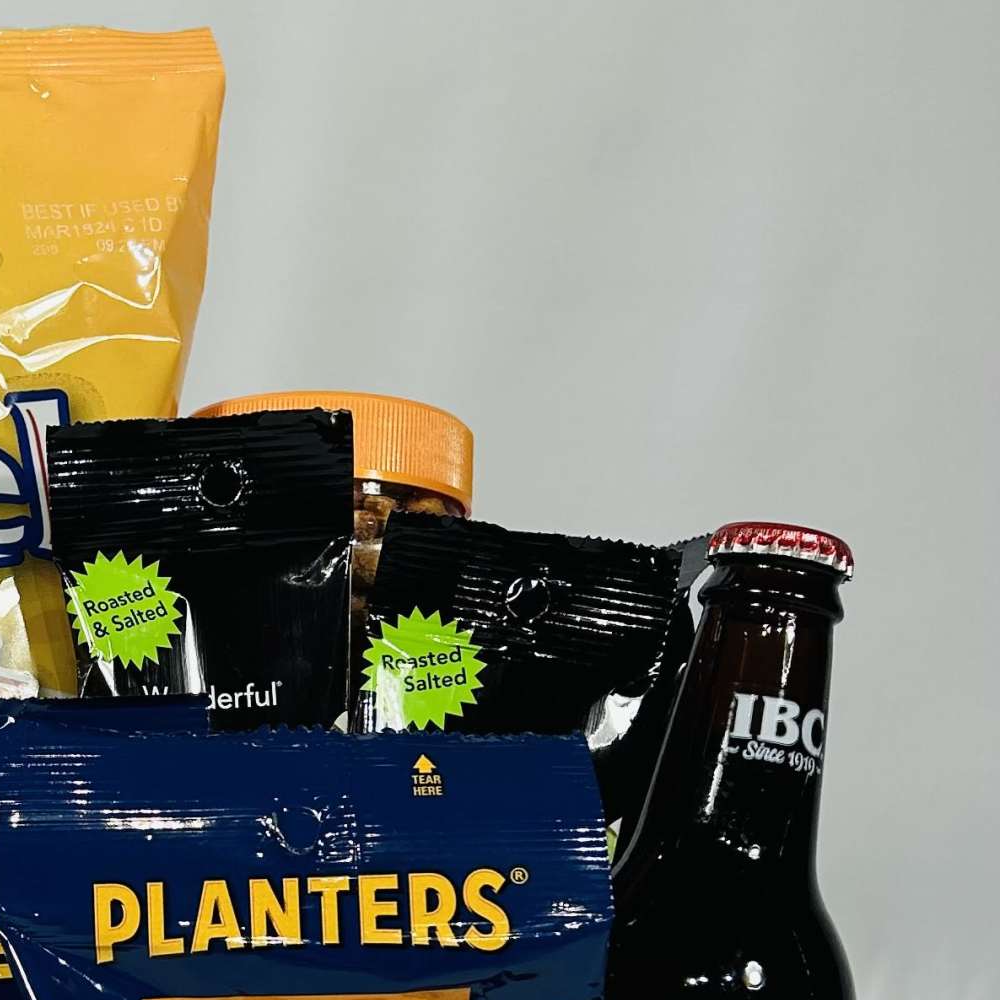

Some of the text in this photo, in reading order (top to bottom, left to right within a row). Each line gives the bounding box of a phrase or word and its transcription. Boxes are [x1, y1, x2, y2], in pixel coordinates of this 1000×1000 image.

[22, 203, 73, 220] BEST
[80, 203, 97, 219] IF
[83, 580, 156, 617] Roasted
[93, 601, 168, 638] & Salted
[382, 645, 462, 670] Roasted
[404, 667, 467, 692] Salted
[729, 691, 825, 758] IBC
[742, 740, 816, 777] Since 1919
[411, 774, 442, 785] TEAR
[412, 785, 444, 797] HERE
